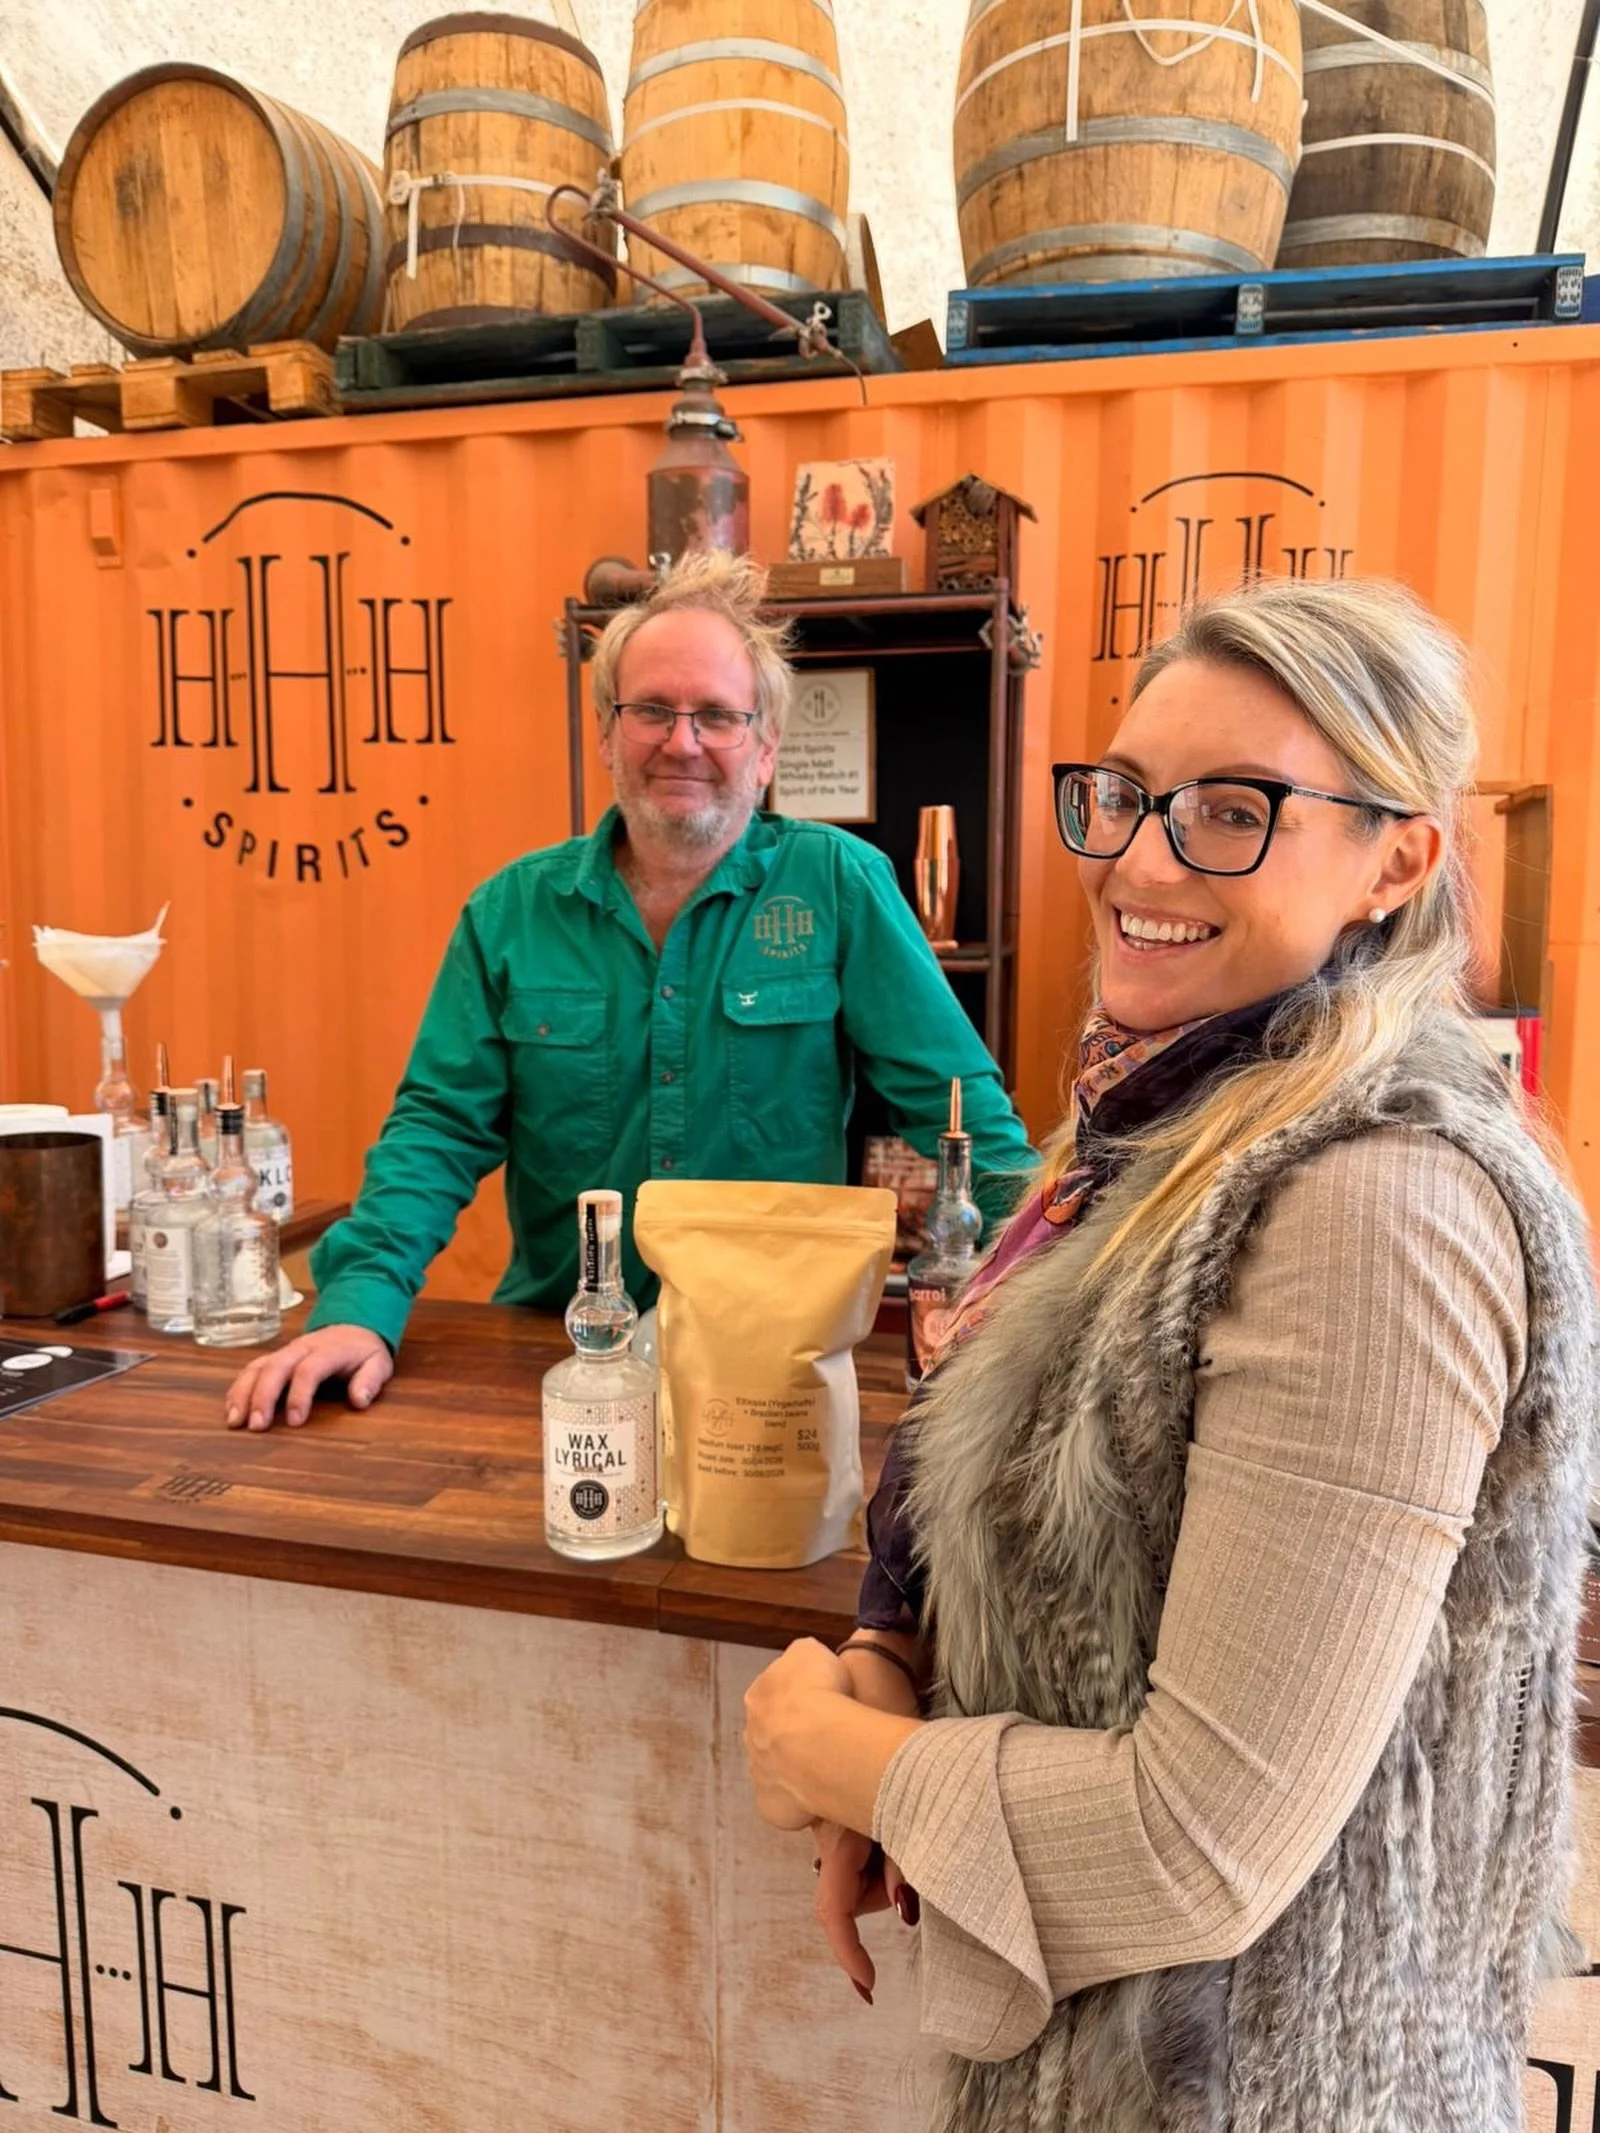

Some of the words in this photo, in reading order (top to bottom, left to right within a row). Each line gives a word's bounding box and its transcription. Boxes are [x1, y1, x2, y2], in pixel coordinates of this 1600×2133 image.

[779, 760, 809, 771] Single
[811, 759, 835, 769] Malt
[779, 772, 815, 782] Whisky
[779, 785, 805, 796] Spirit
[203, 809, 410, 882] SPIRITS
[568, 1432, 609, 1451] WAX
[554, 1447, 628, 1469] LYRICAL
